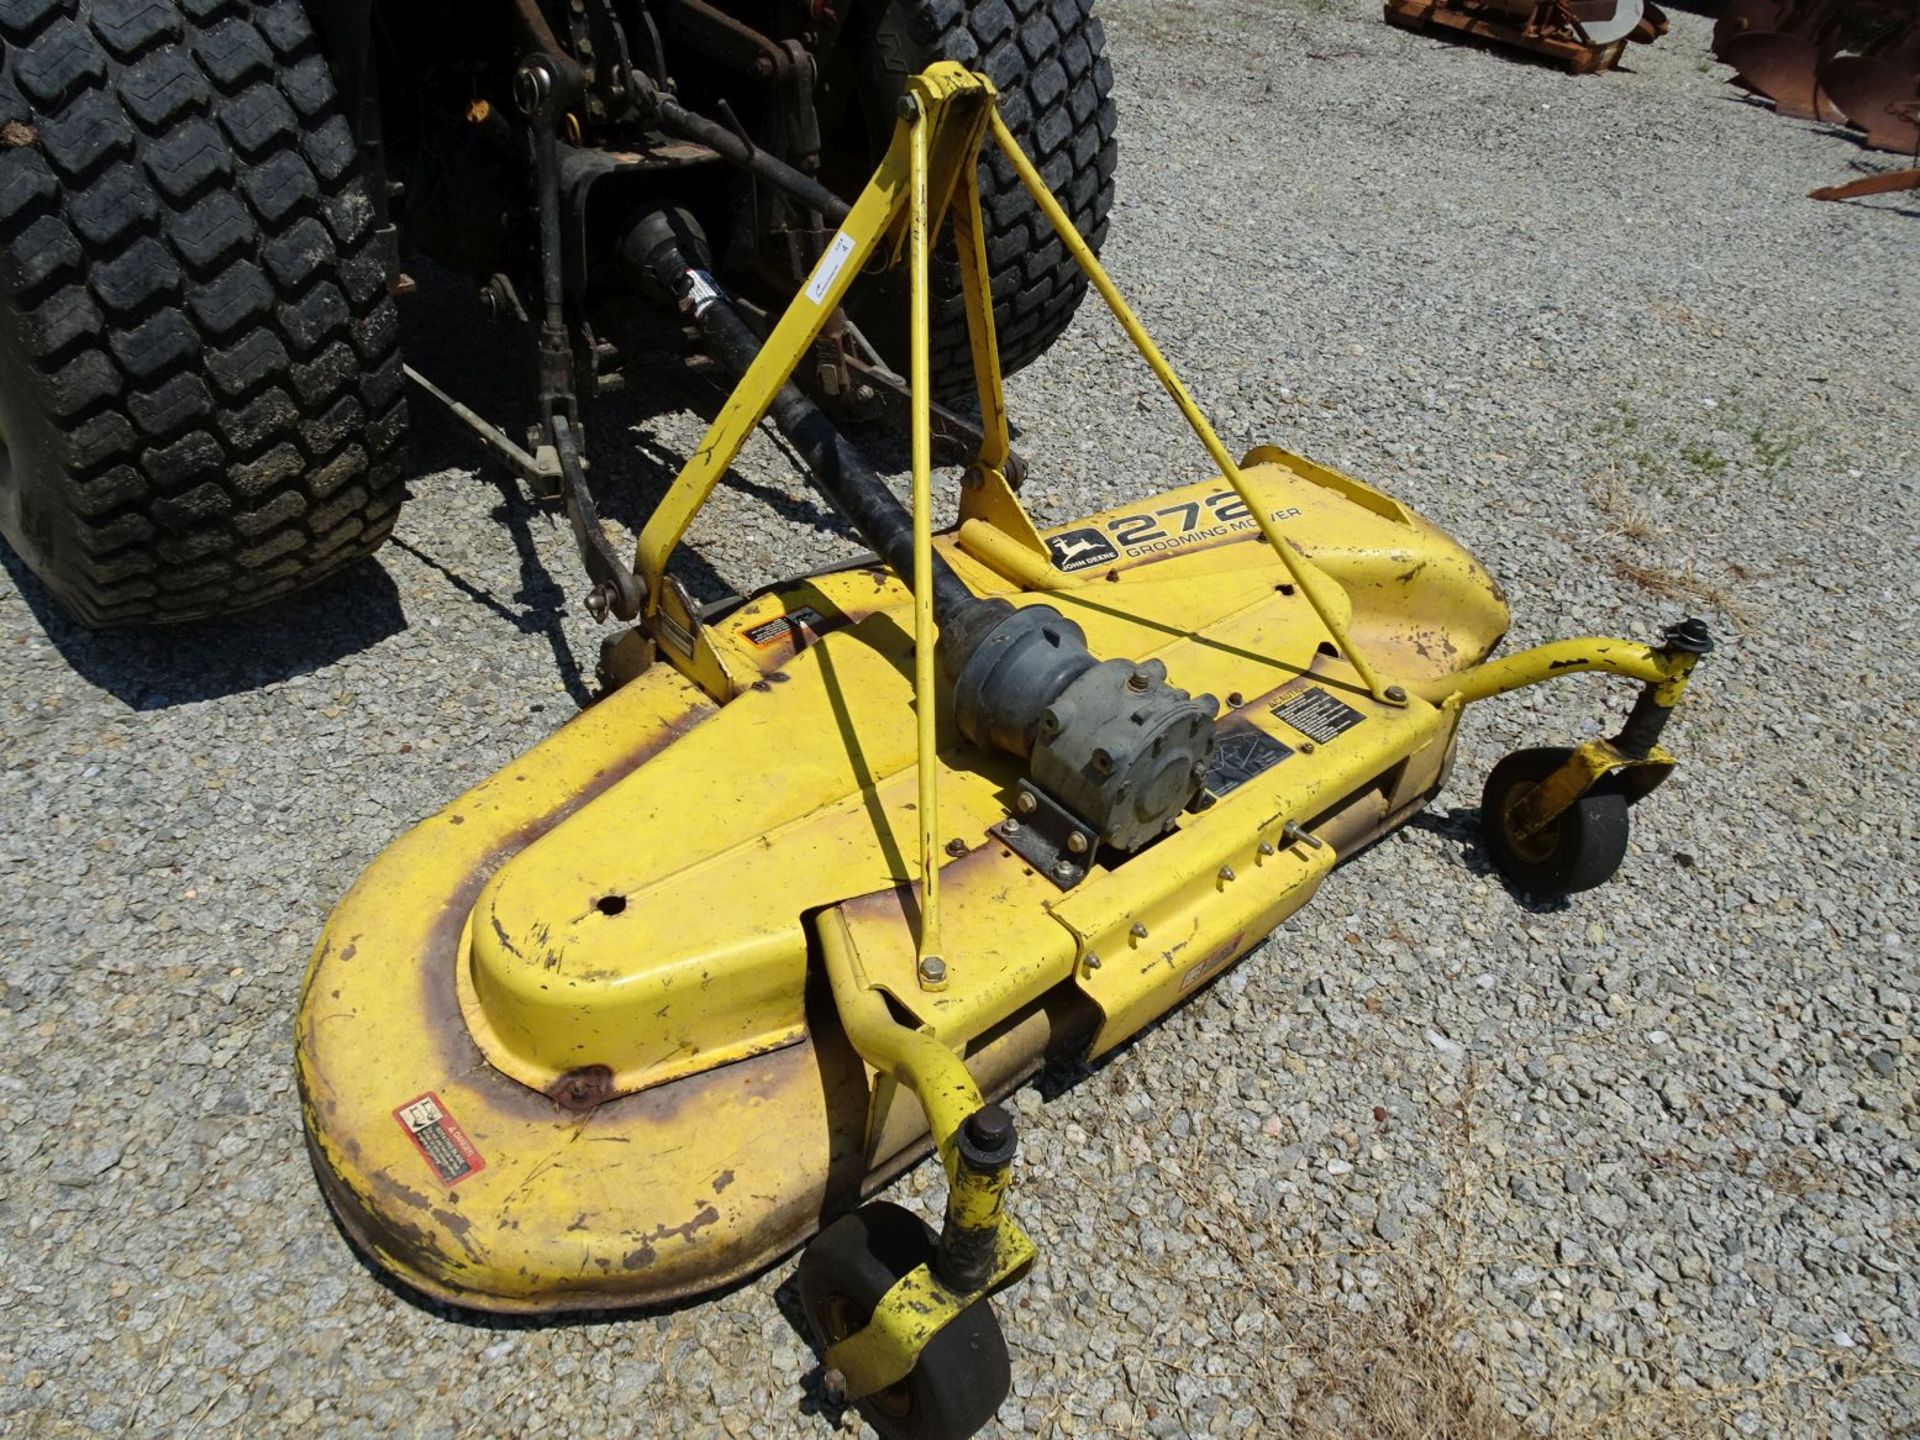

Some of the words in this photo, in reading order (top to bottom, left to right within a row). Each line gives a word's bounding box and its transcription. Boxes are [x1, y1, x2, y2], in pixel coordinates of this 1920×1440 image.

[1106, 490, 1251, 547] 272
[1126, 525, 1228, 558] GROOMING
[1230, 507, 1302, 531] MOER
[1062, 560, 1086, 571] JOHN
[1086, 552, 1117, 564] DEERE
